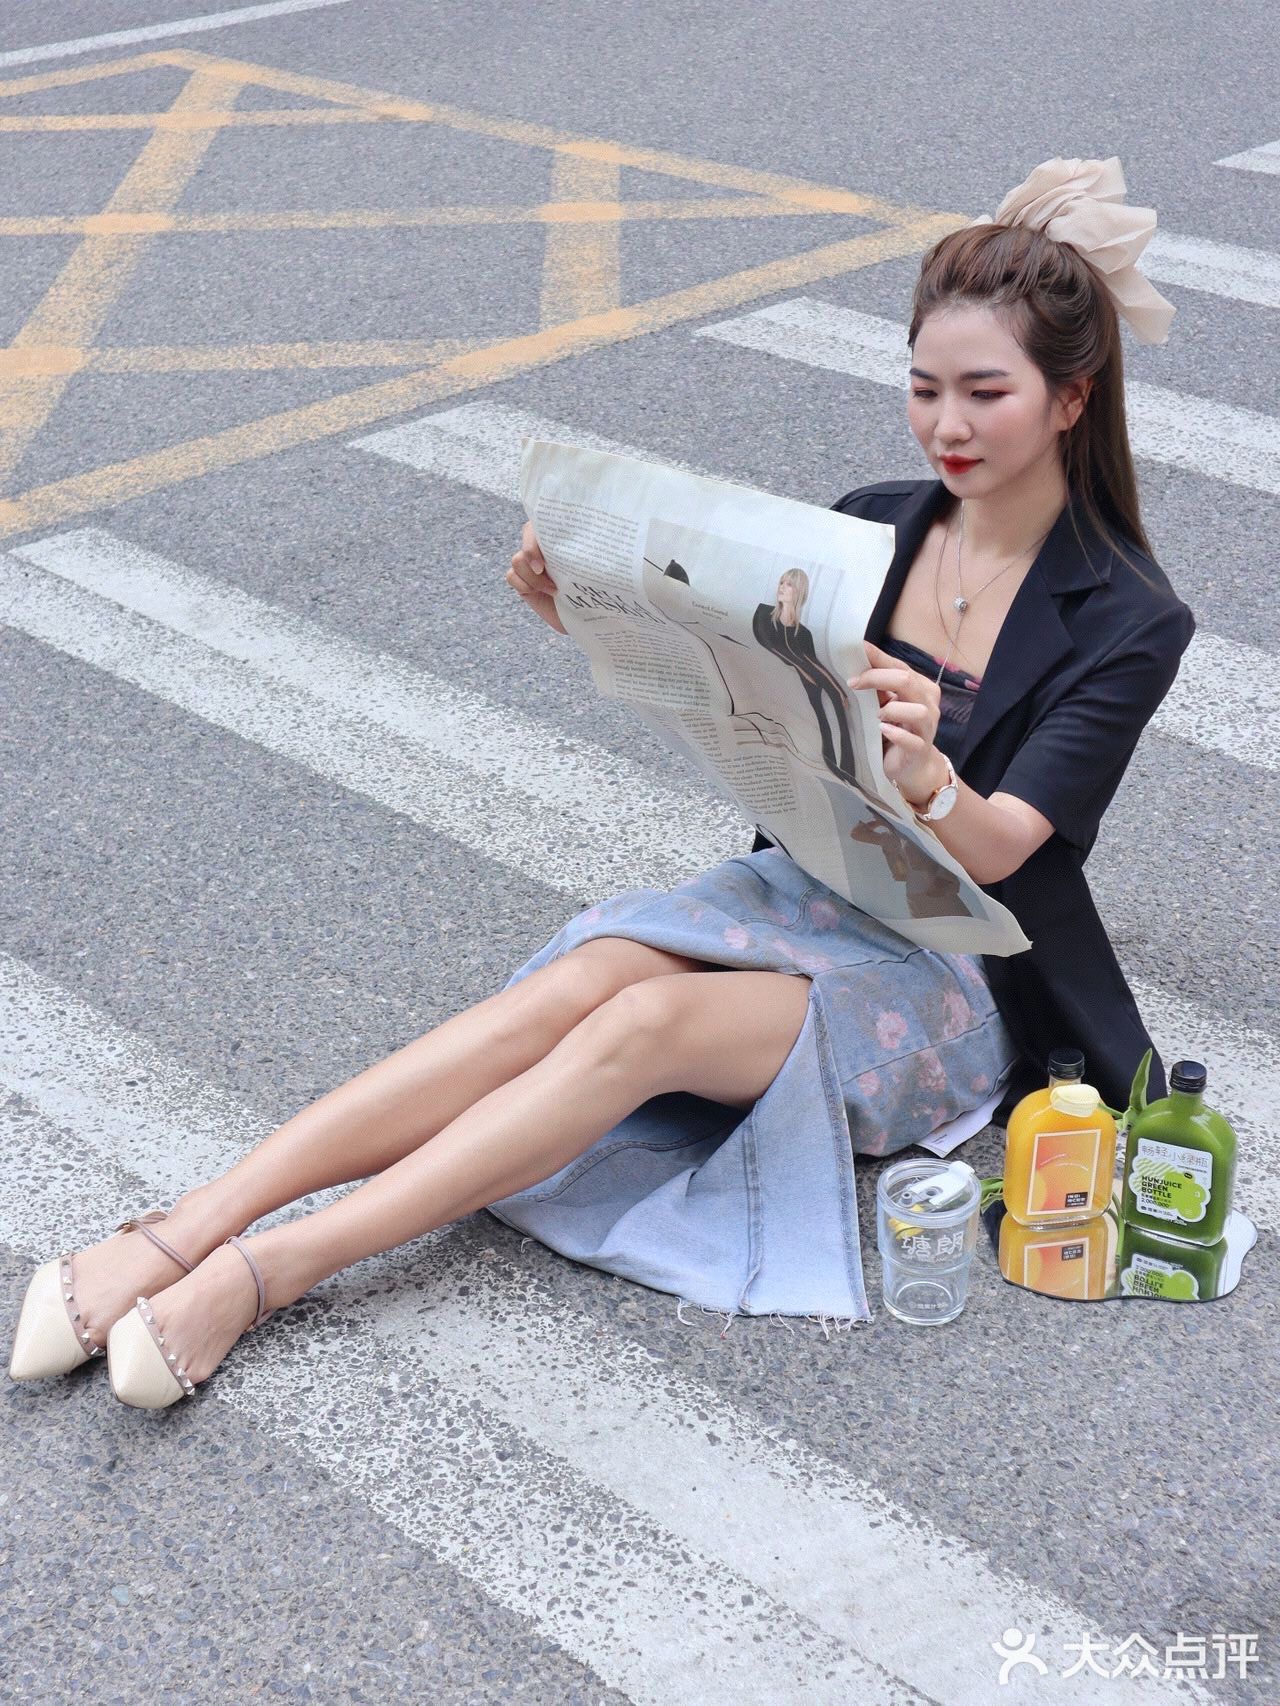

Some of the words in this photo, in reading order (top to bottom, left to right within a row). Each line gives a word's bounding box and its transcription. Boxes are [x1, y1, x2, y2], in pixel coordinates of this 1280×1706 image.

[1141, 1175, 1183, 1190] HUNJUICE
[1141, 1181, 1168, 1192] GREEN
[1141, 1187, 1172, 1199] BOTTLE
[901, 1231, 965, 1258] 塘朗
